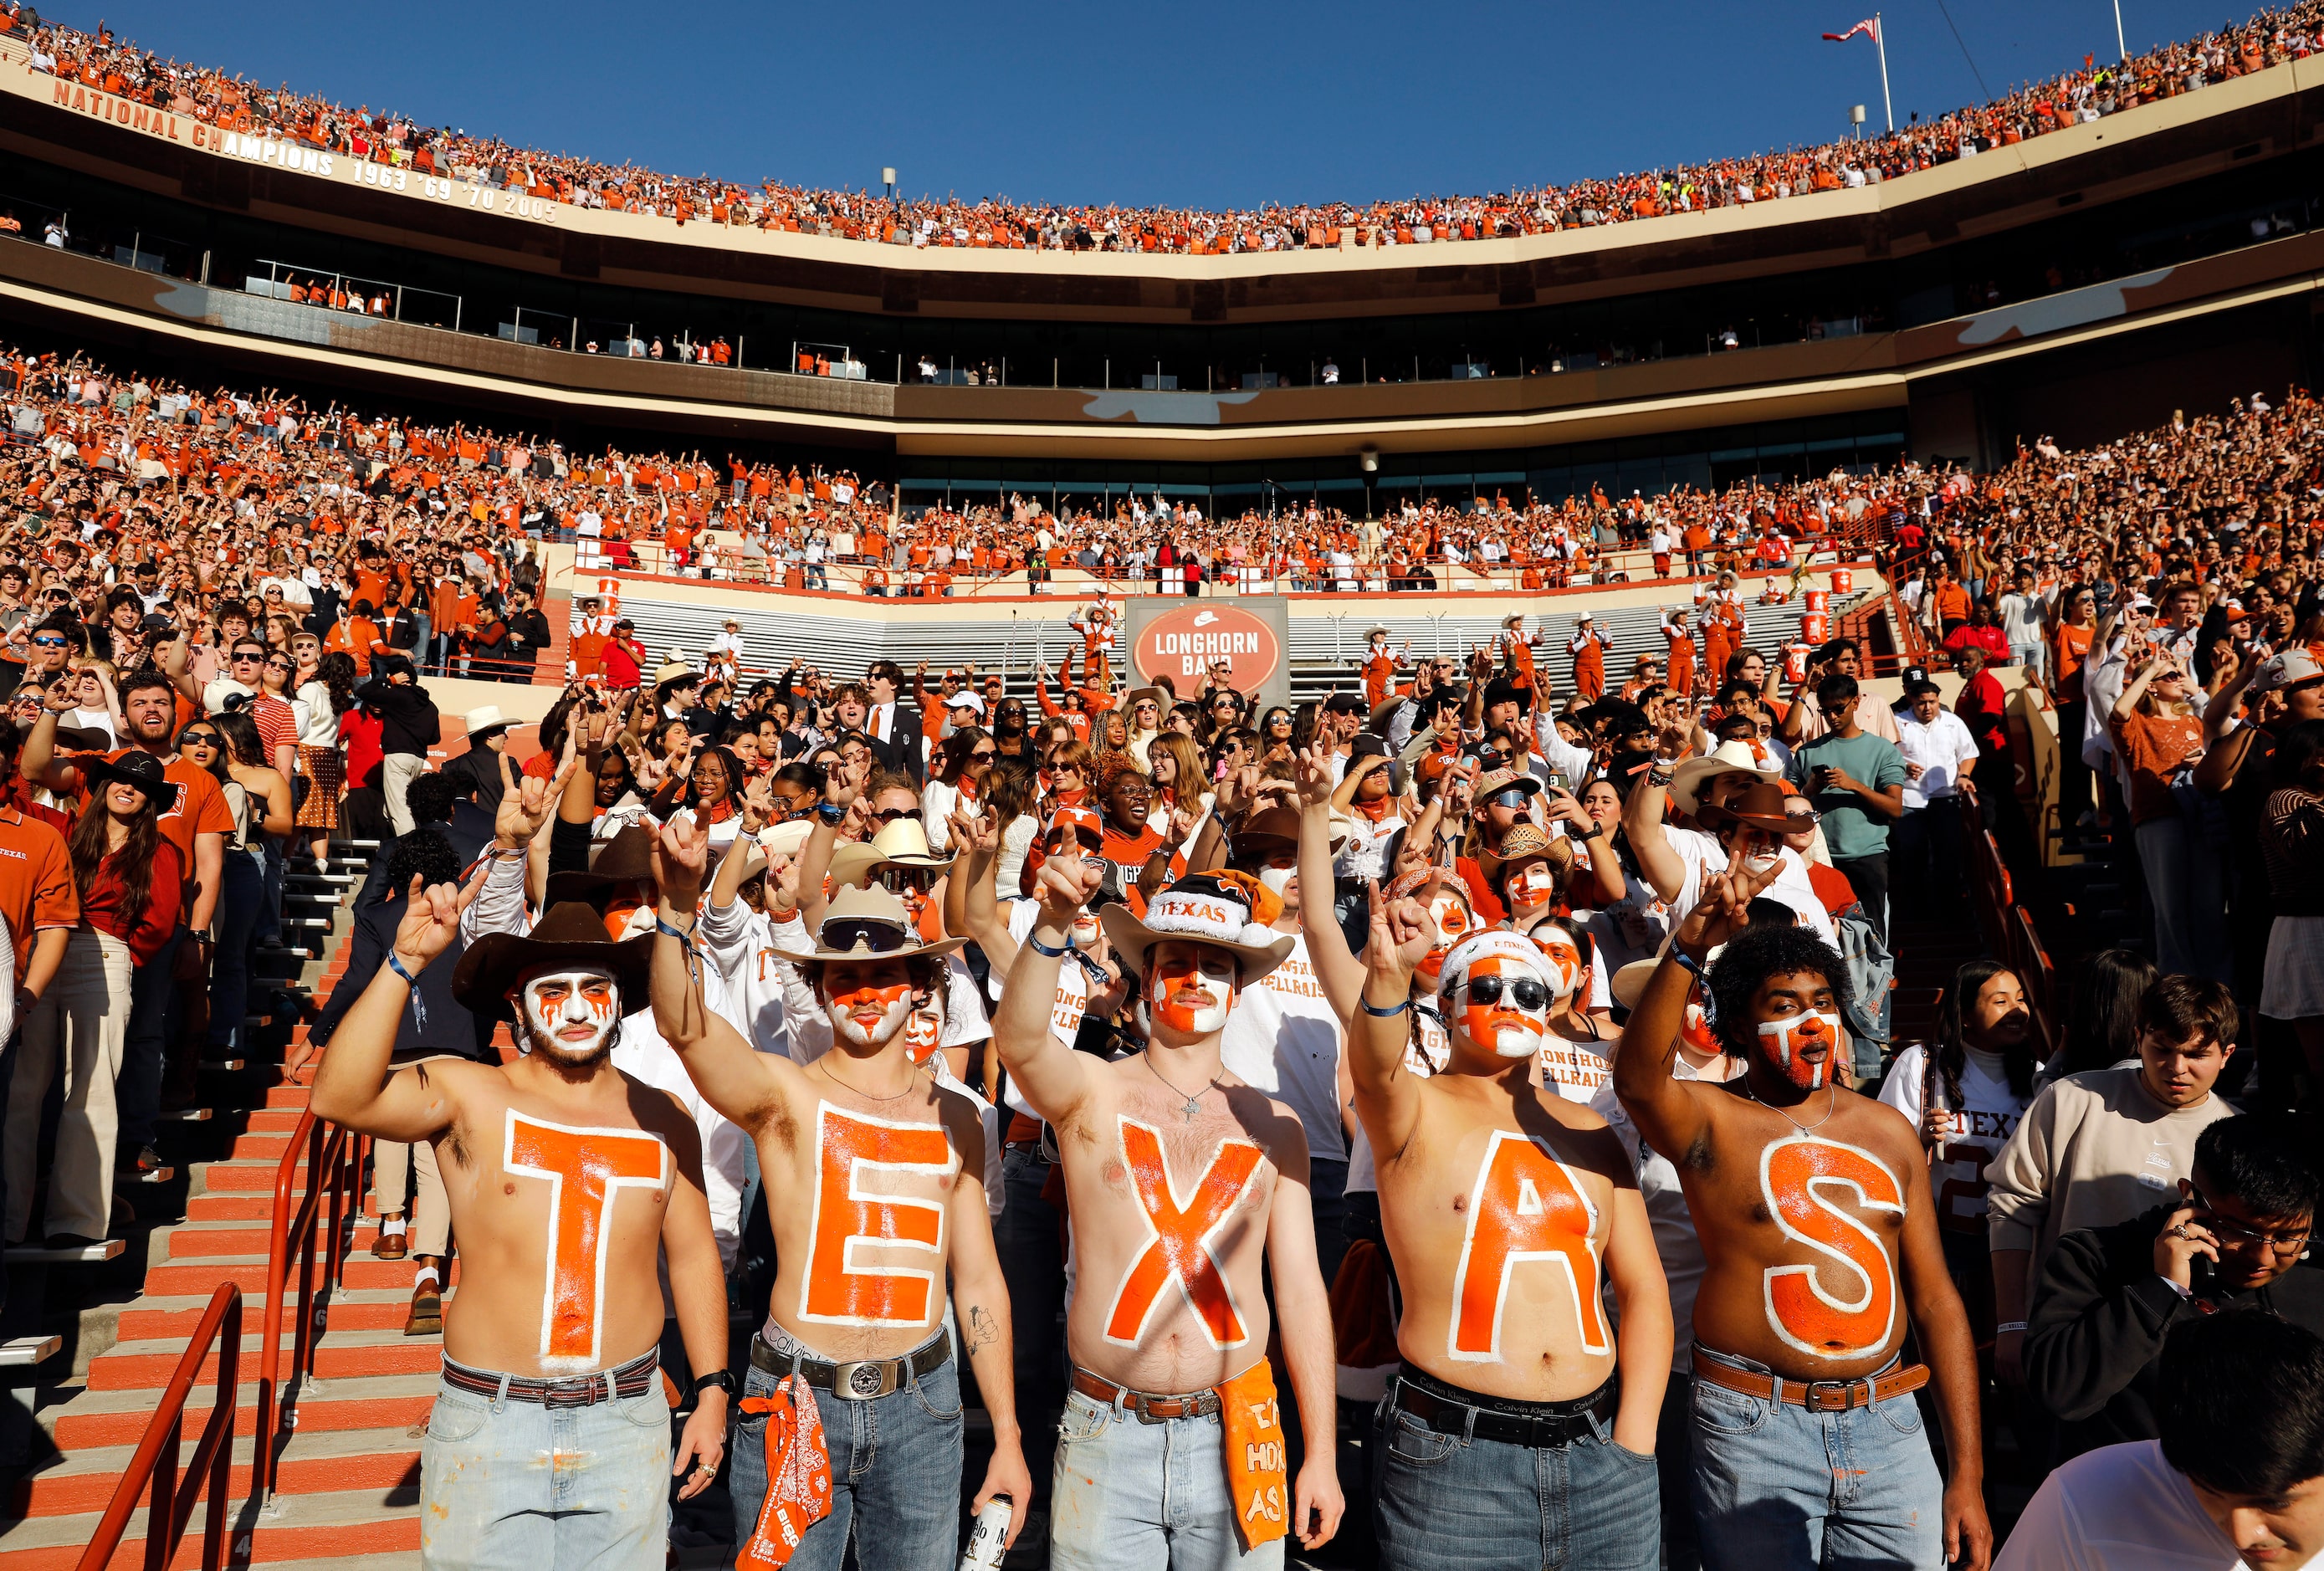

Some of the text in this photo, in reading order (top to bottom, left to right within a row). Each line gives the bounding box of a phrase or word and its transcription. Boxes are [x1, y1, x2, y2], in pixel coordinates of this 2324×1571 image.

[53, 80, 179, 140] NATIONAL
[192, 124, 334, 177] CHAMPIONS
[353, 161, 407, 192] 1963
[504, 193, 557, 223] 2005
[1155, 632, 1258, 655] LONGHORN
[1438, 755, 1456, 765] Tex
[1161, 900, 1226, 924] TEXAS
[504, 1098, 1907, 1370] T E X A S
[769, 1326, 811, 1359] Calvin
[1420, 1376, 1471, 1404] Calvin Klein
[1494, 1402, 1554, 1415] Calvin Klein
